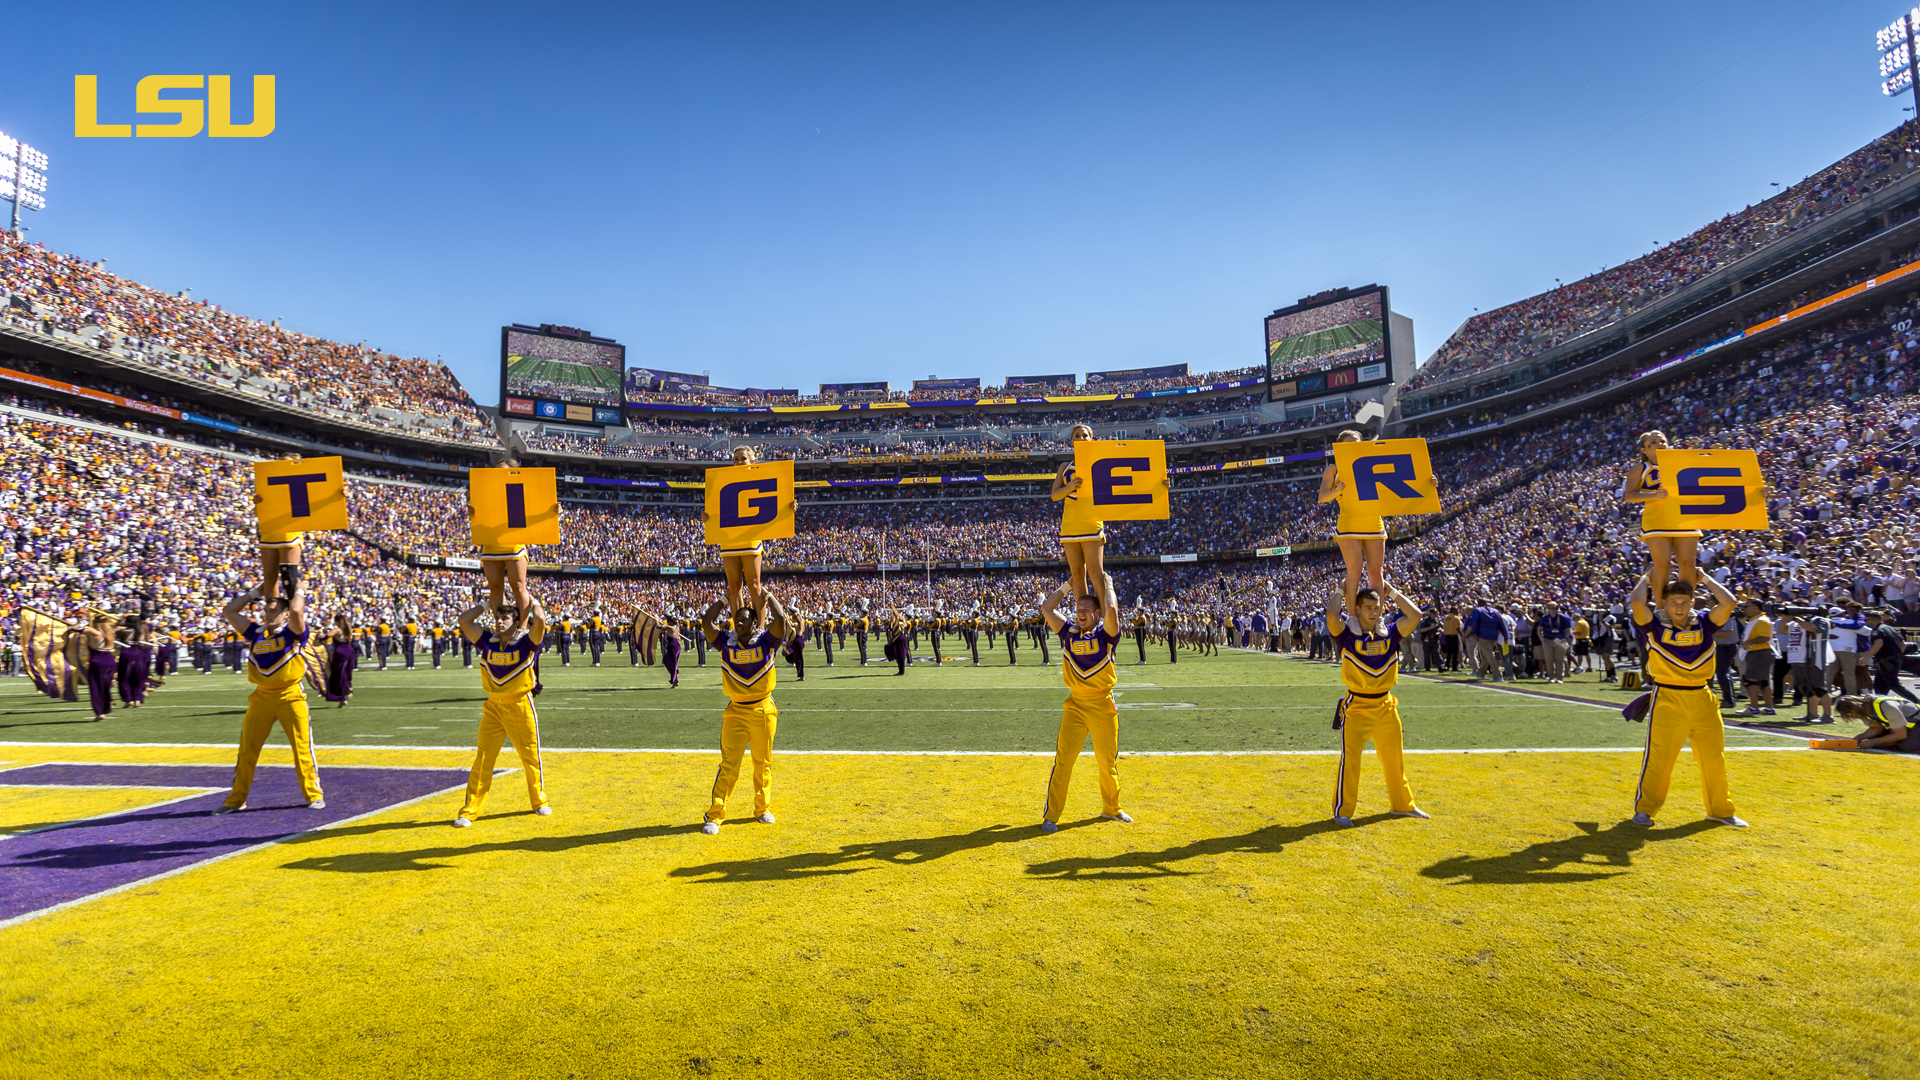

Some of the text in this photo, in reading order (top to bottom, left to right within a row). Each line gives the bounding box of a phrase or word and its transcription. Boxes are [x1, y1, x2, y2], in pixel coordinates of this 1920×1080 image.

[1307, 288, 1337, 305] LSU
[551, 324, 581, 337] LSU
[1758, 366, 1772, 378] 101
[848, 451, 1030, 464] WELCOME TO DEATH VALLEY
[1091, 457, 1153, 506] E
[1352, 454, 1424, 500] R
[267, 473, 327, 518] T
[1676, 468, 1747, 514] S
[506, 483, 526, 528] I
[720, 478, 778, 528] G
[1661, 628, 1704, 646] LSU
[729, 646, 764, 664] LSU
[1070, 638, 1100, 655] LSU
[1355, 638, 1392, 656] LSU
[486, 650, 520, 666] LSU
[1624, 672, 1635, 688] 10
